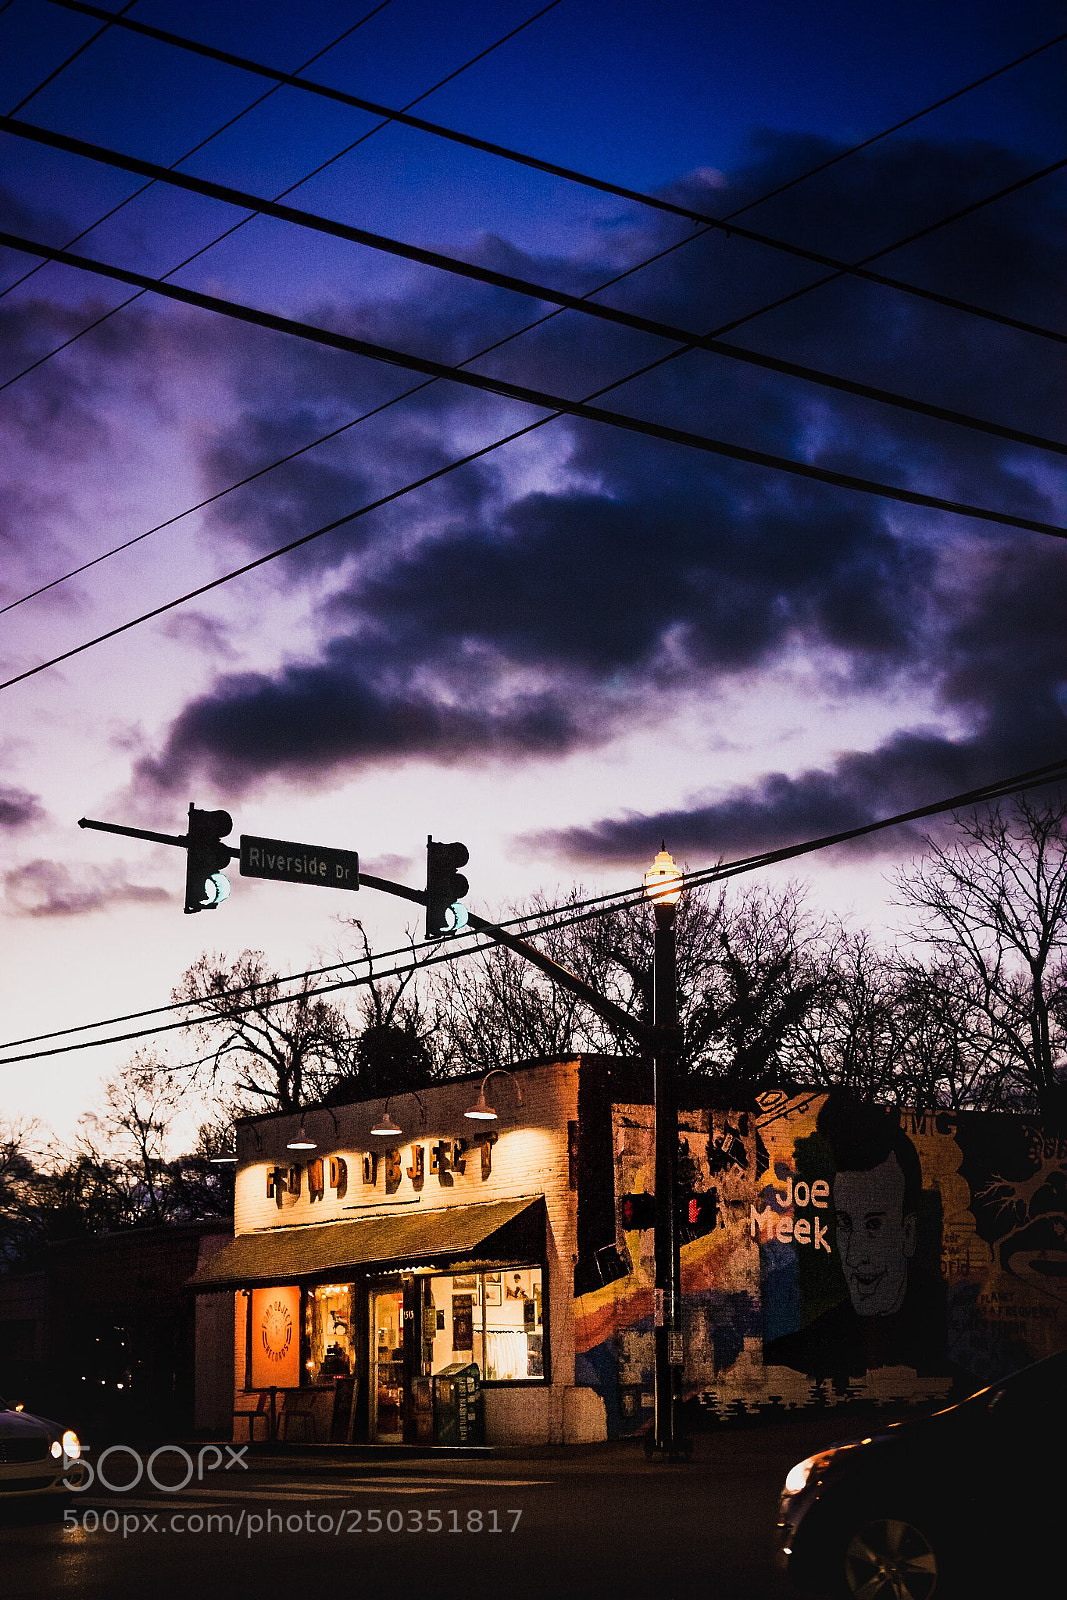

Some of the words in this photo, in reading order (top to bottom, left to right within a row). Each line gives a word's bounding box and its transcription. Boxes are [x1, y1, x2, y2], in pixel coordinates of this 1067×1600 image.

[248, 846, 327, 878] Riverside
[335, 864, 350, 880] Dr
[362, 1131, 498, 1190] OBJECT
[774, 1175, 831, 1209] Joe
[749, 1202, 833, 1254] Meek
